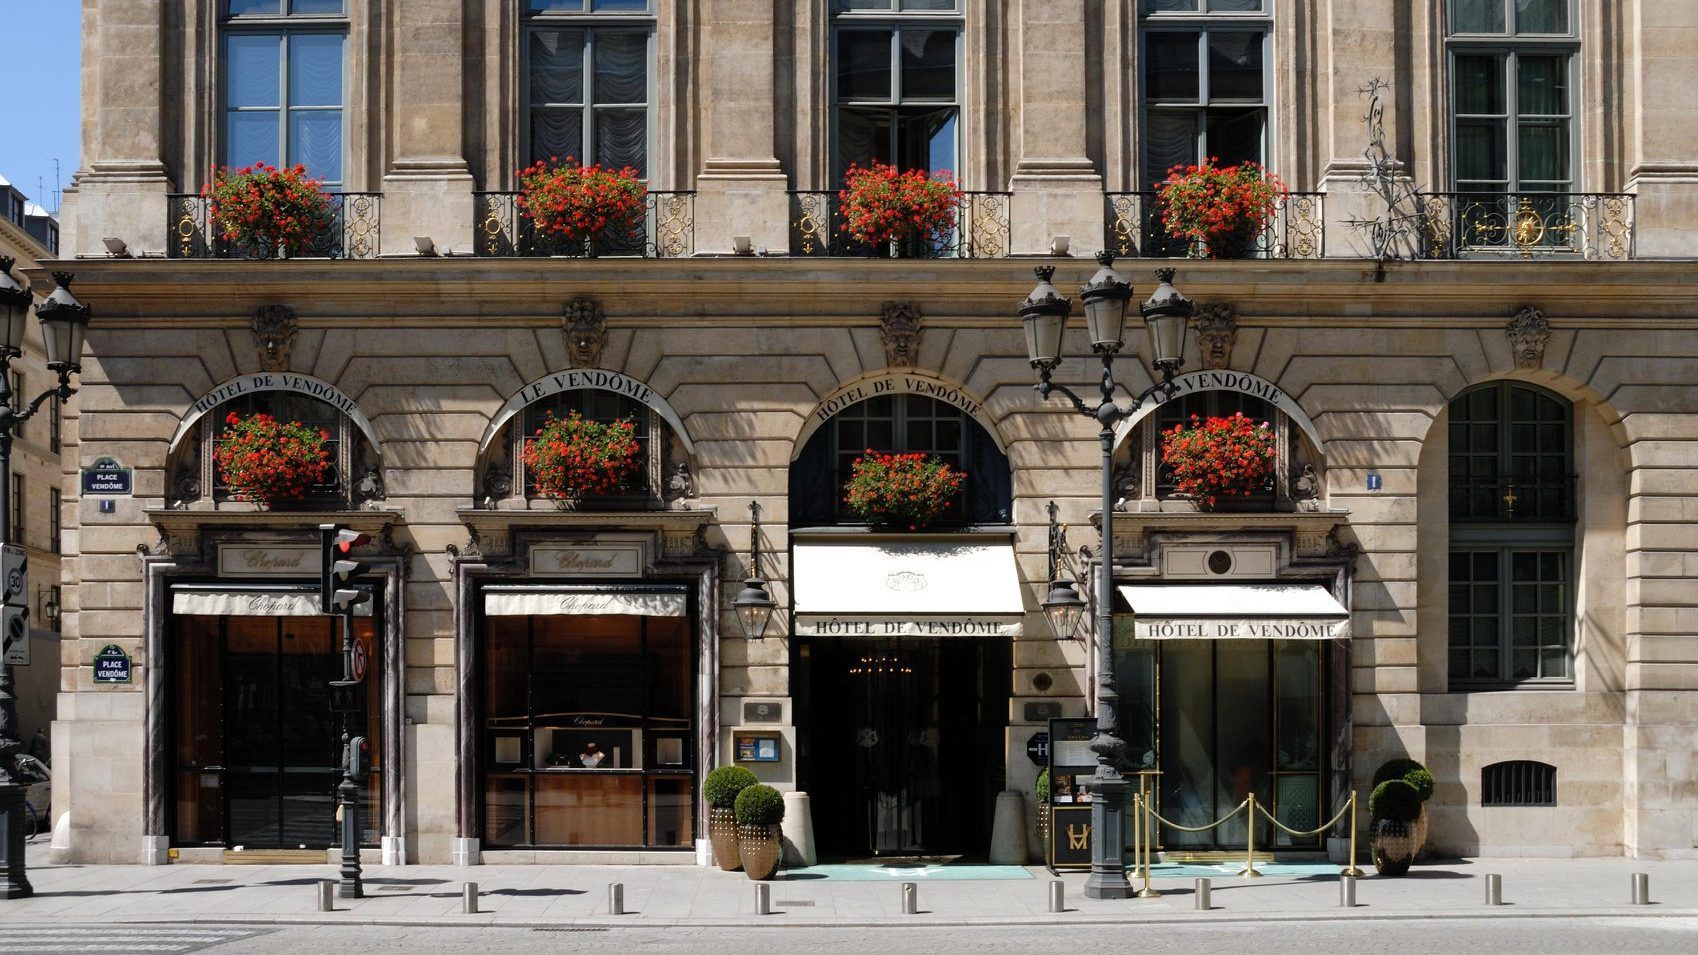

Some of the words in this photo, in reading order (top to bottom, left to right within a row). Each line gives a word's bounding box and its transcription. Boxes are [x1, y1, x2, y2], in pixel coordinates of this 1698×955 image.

[195, 381, 247, 413] HÔTEL
[253, 375, 274, 388] DE
[283, 375, 358, 416] VENDÔME
[520, 382, 546, 403] LE
[553, 371, 654, 404] VENDÔME
[1183, 373, 1283, 404] VENDÔME
[816, 387, 868, 421] HÔTEL
[873, 378, 895, 393] DE
[905, 378, 982, 418] VENDÔME
[91, 481, 124, 490] VENDÔME
[242, 549, 305, 570] Chopard
[554, 550, 618, 571] Chopard
[11, 575, 21, 589] 30
[248, 594, 300, 615] Chopard
[559, 595, 617, 613] Chopard
[816, 618, 876, 634] HÔTEL
[884, 621, 904, 634] DE
[916, 618, 1004, 634] VENDÔME
[1149, 620, 1209, 638] HÔTEL
[1217, 624, 1240, 637] DE
[1249, 621, 1337, 638] VENDÔME
[102, 660, 123, 668] PLACE
[97, 669, 128, 678] VENDÔME
[572, 714, 605, 727] Chopard
